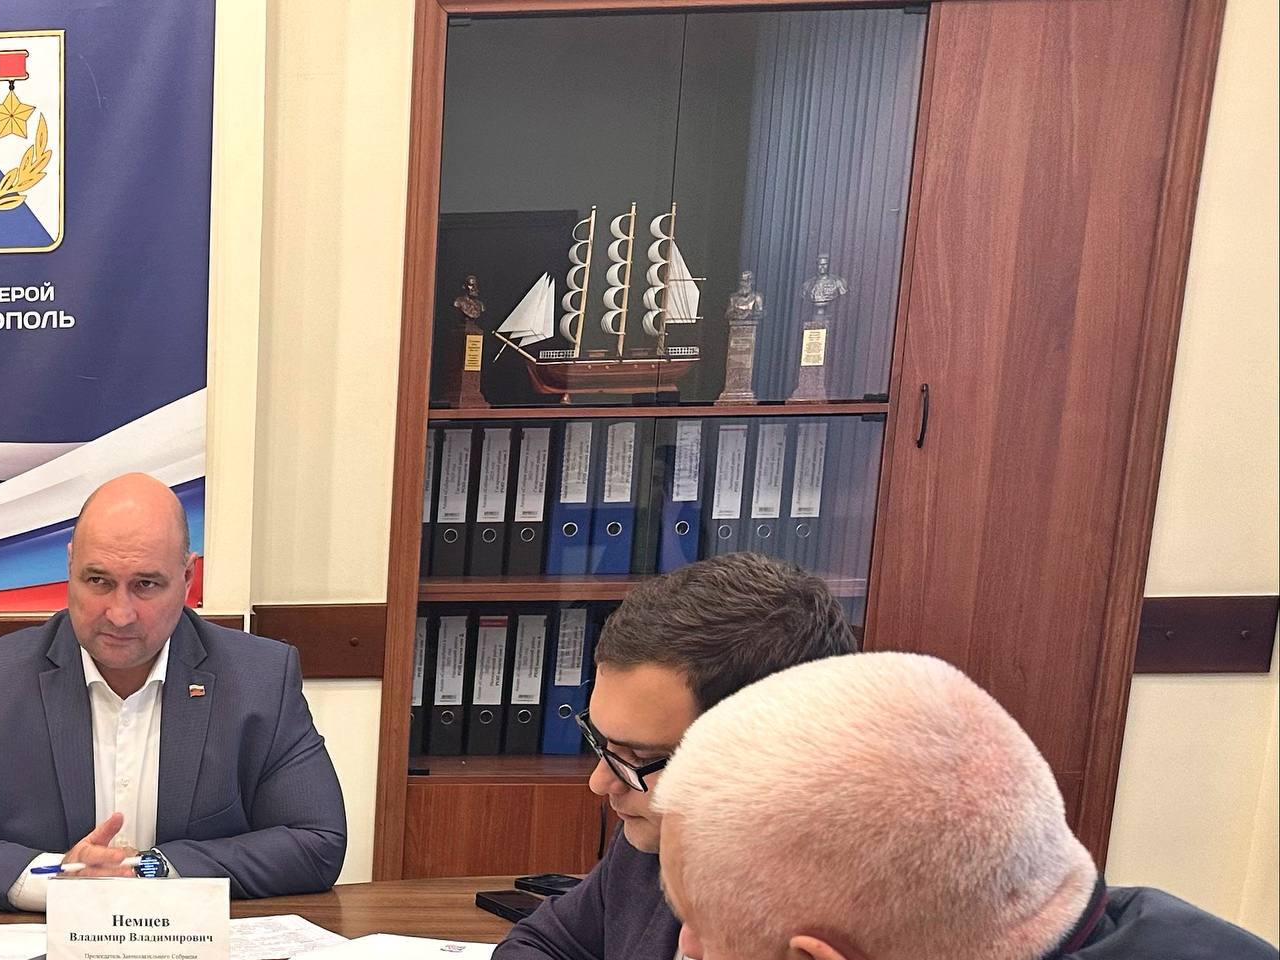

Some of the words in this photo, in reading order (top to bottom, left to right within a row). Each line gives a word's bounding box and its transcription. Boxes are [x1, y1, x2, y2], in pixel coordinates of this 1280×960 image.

[112, 914, 170, 928] Немцев
[70, 932, 126, 944] Владимир
[129, 932, 213, 944] Владимирович
